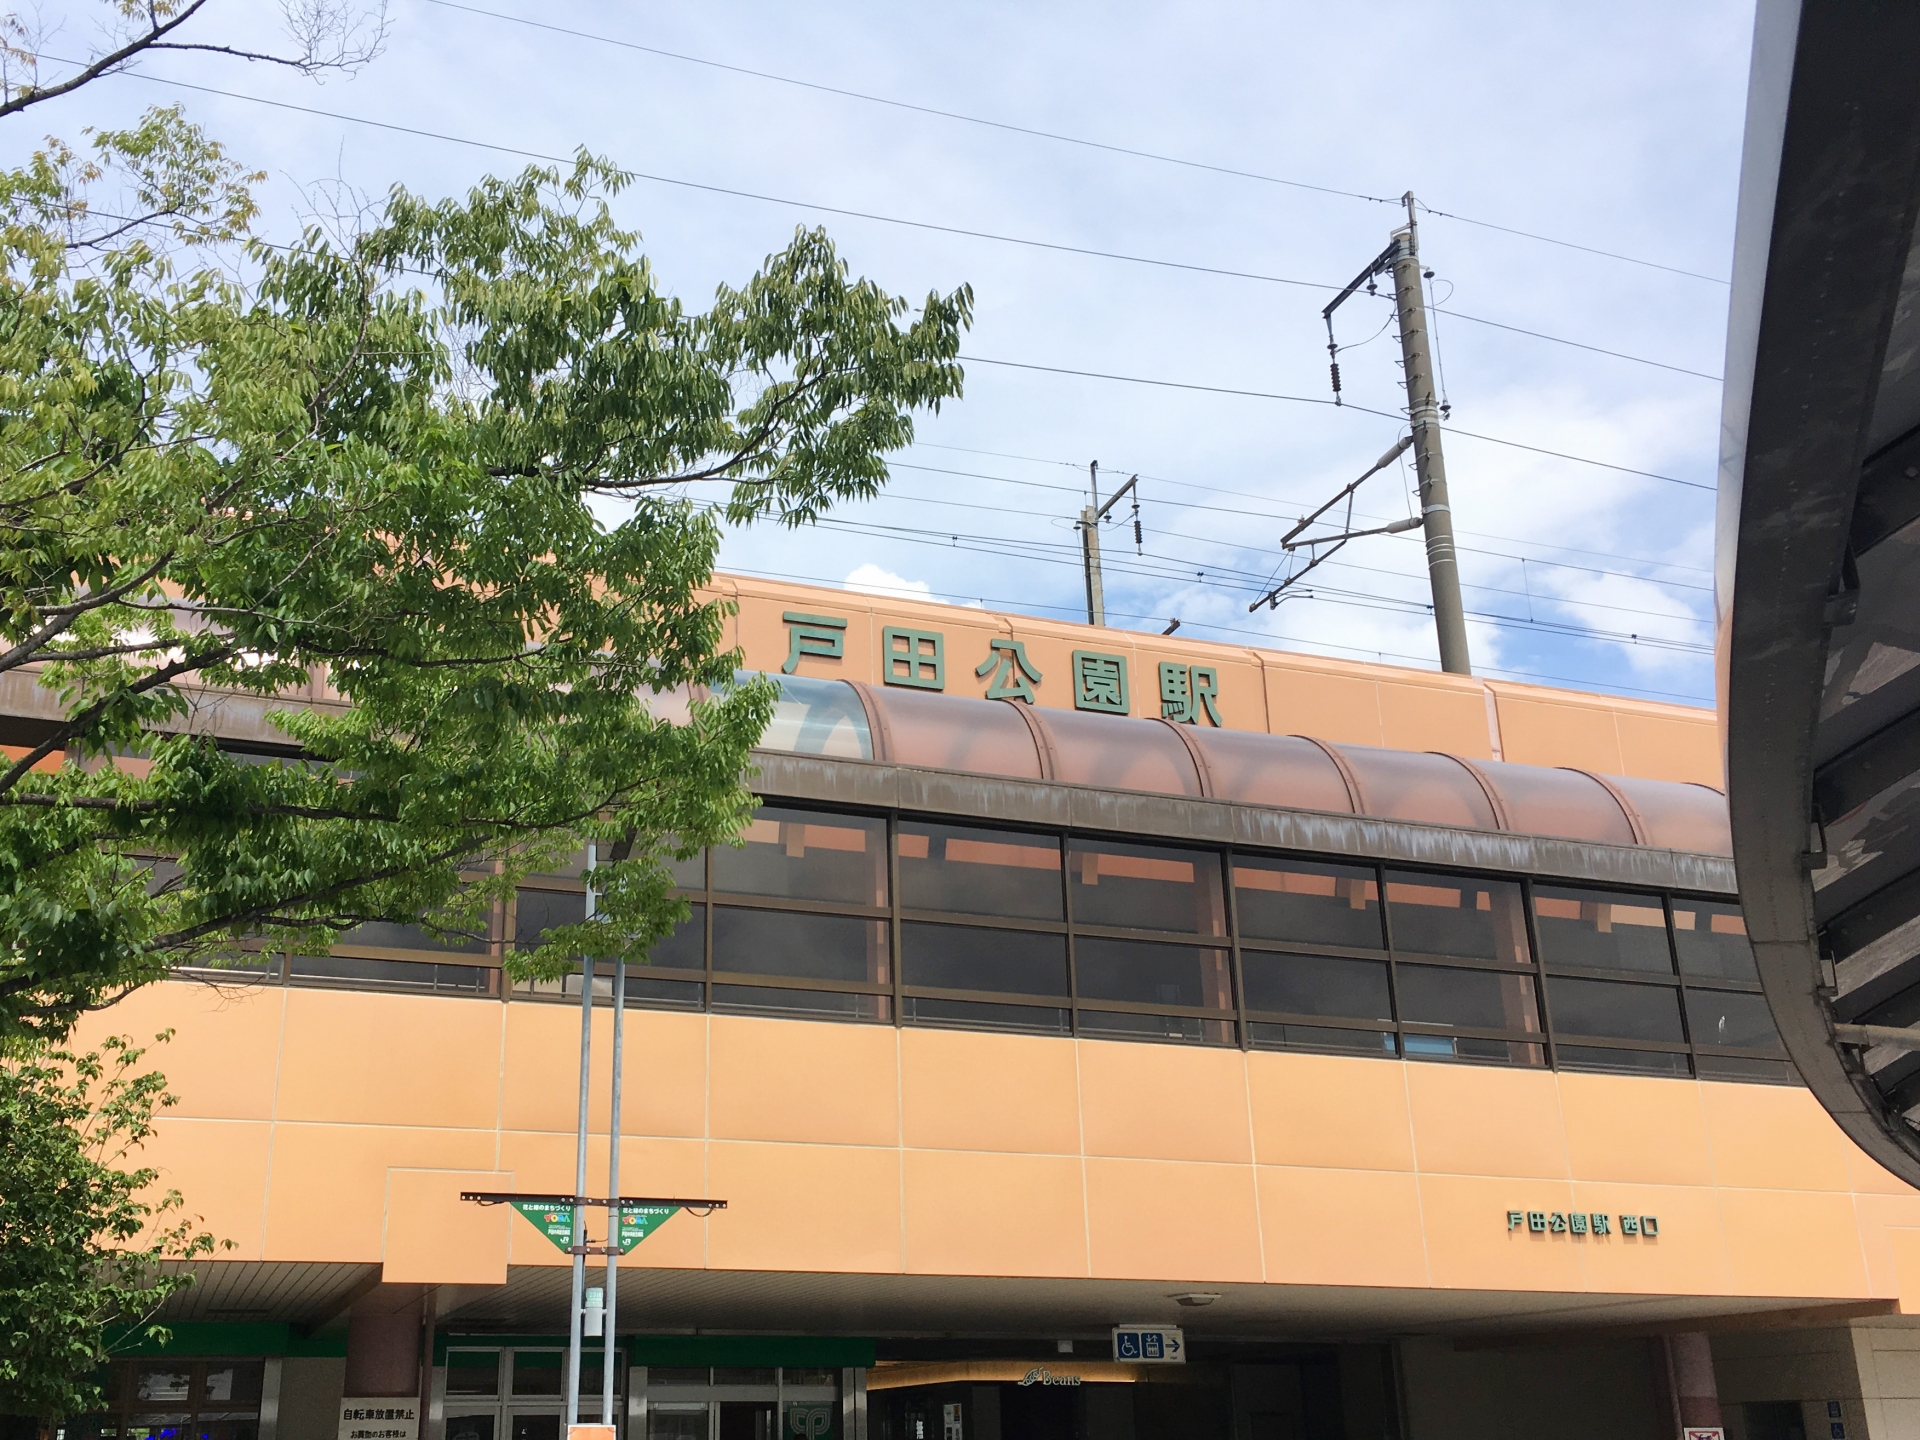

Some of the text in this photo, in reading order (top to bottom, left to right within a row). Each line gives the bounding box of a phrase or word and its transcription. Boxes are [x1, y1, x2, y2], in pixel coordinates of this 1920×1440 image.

[782, 610, 1223, 728] 戸田公園駅
[1507, 1210, 1660, 1236] 戸田公園駅 西口
[1043, 1370, 1081, 1386] Beans
[343, 1408, 415, 1421] 自転車放置禁止
